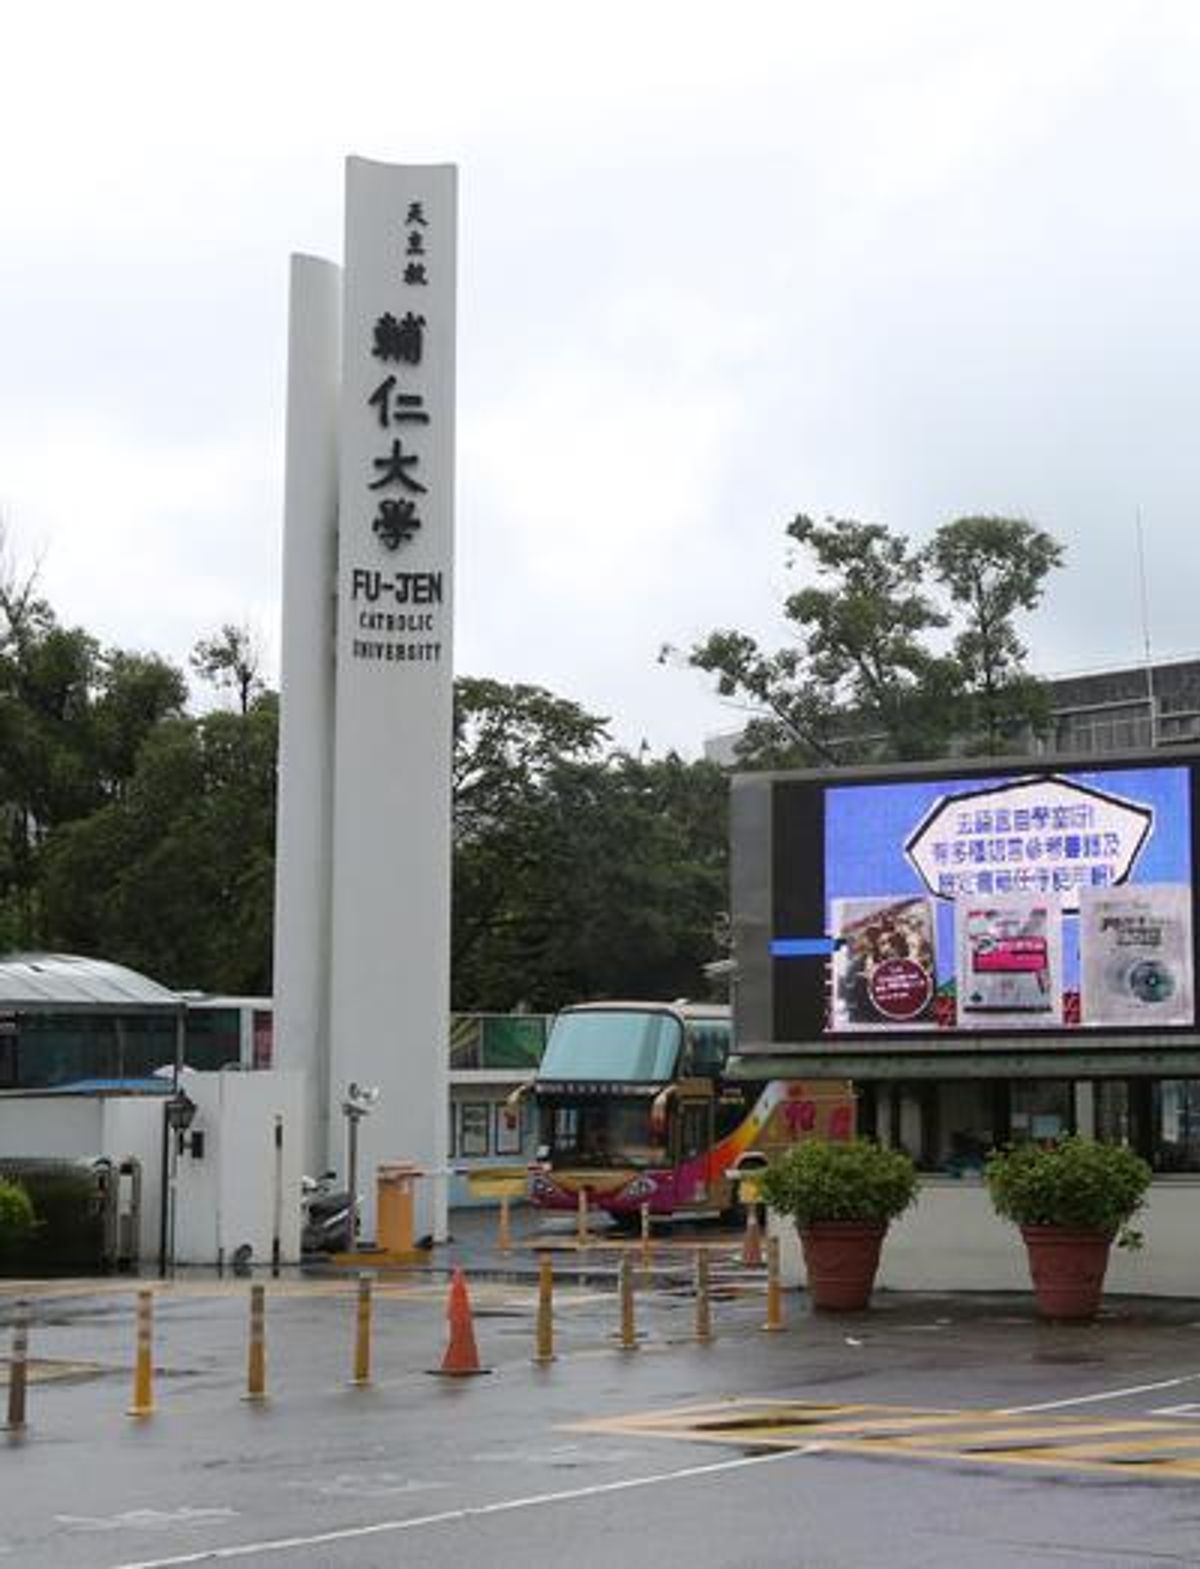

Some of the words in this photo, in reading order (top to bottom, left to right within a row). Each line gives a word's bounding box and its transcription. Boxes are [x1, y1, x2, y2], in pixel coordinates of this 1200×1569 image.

[368, 311, 430, 551] 輔仁大學
[352, 569, 443, 604] FU-JEN
[359, 610, 433, 631] CATHOLIC
[353, 638, 442, 662] UNIVERSITY
